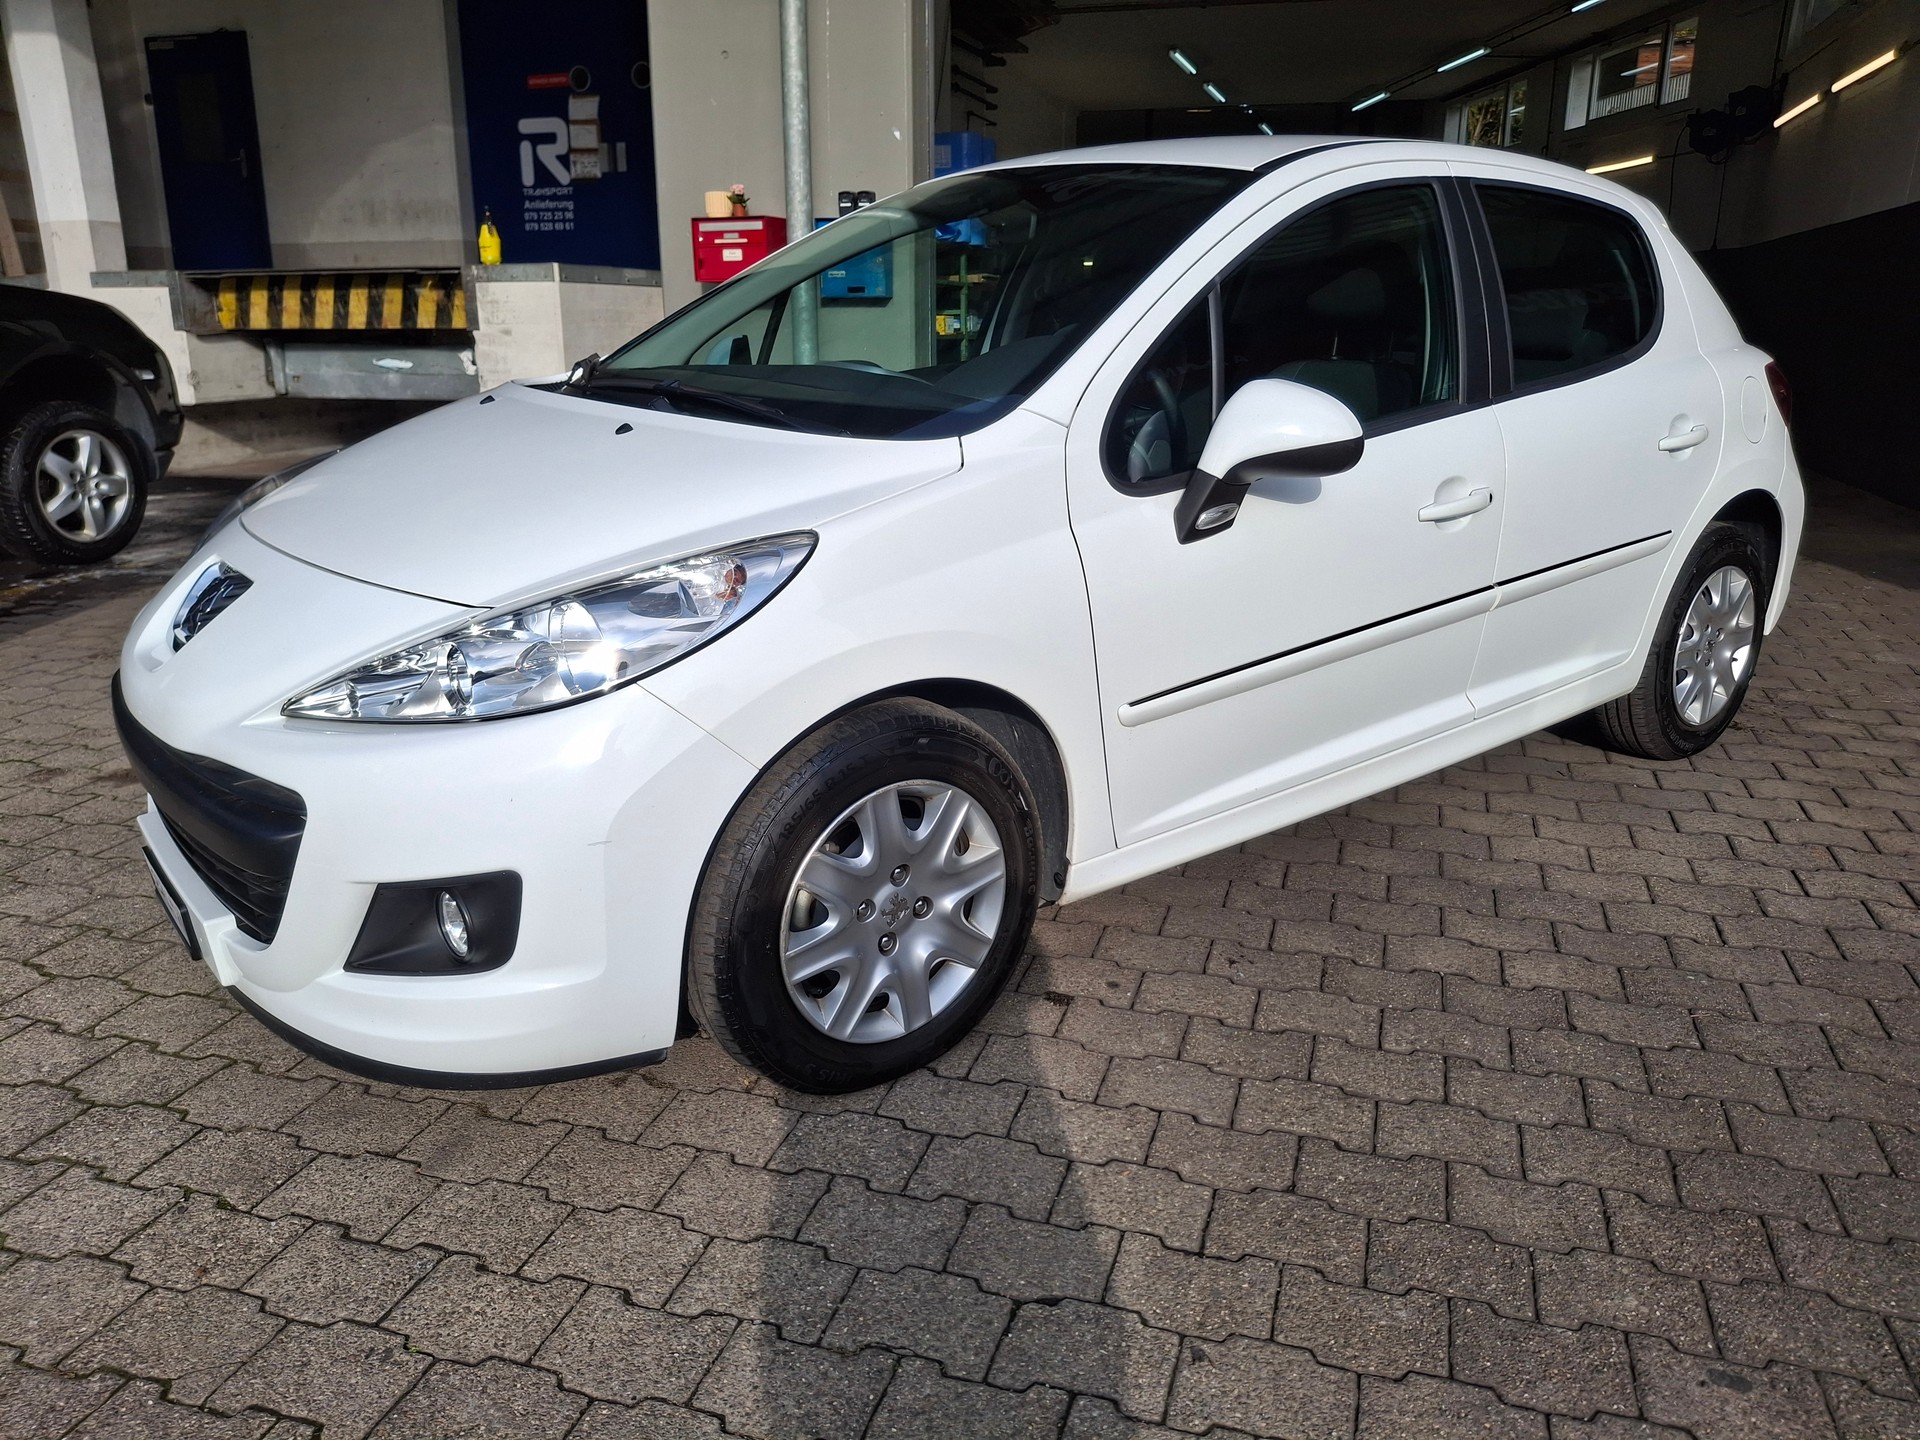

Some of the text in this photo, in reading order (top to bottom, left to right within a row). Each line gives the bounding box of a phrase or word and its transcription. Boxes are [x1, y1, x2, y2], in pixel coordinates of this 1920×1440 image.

[517, 116, 571, 187] R
[522, 187, 574, 196] TRANSPORT
[523, 199, 574, 211] Anlieferung
[523, 211, 539, 220] 079
[524, 222, 539, 231] 079
[779, 788, 822, 840] 185/65
